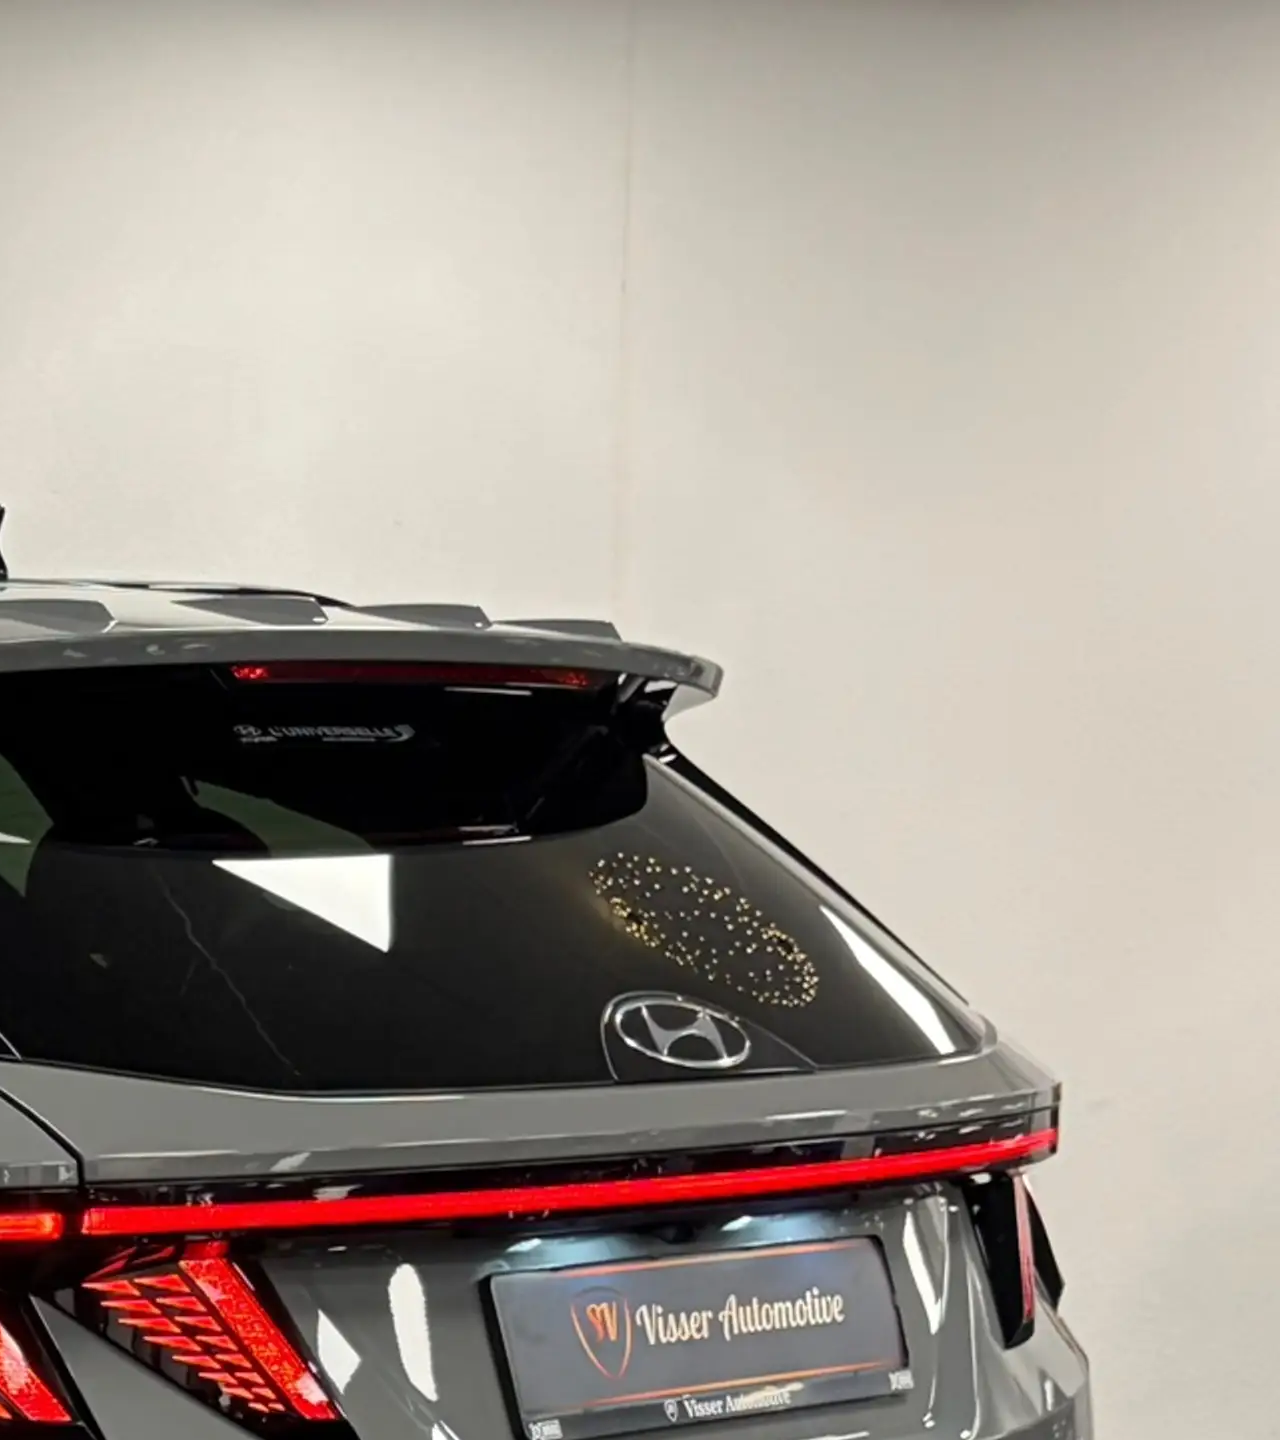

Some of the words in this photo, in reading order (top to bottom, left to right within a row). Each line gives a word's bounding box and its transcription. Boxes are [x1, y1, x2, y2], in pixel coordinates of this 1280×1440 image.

[635, 1302, 714, 1346] Visser
[718, 1286, 846, 1341] Automotive
[682, 1395, 724, 1419] Visser
